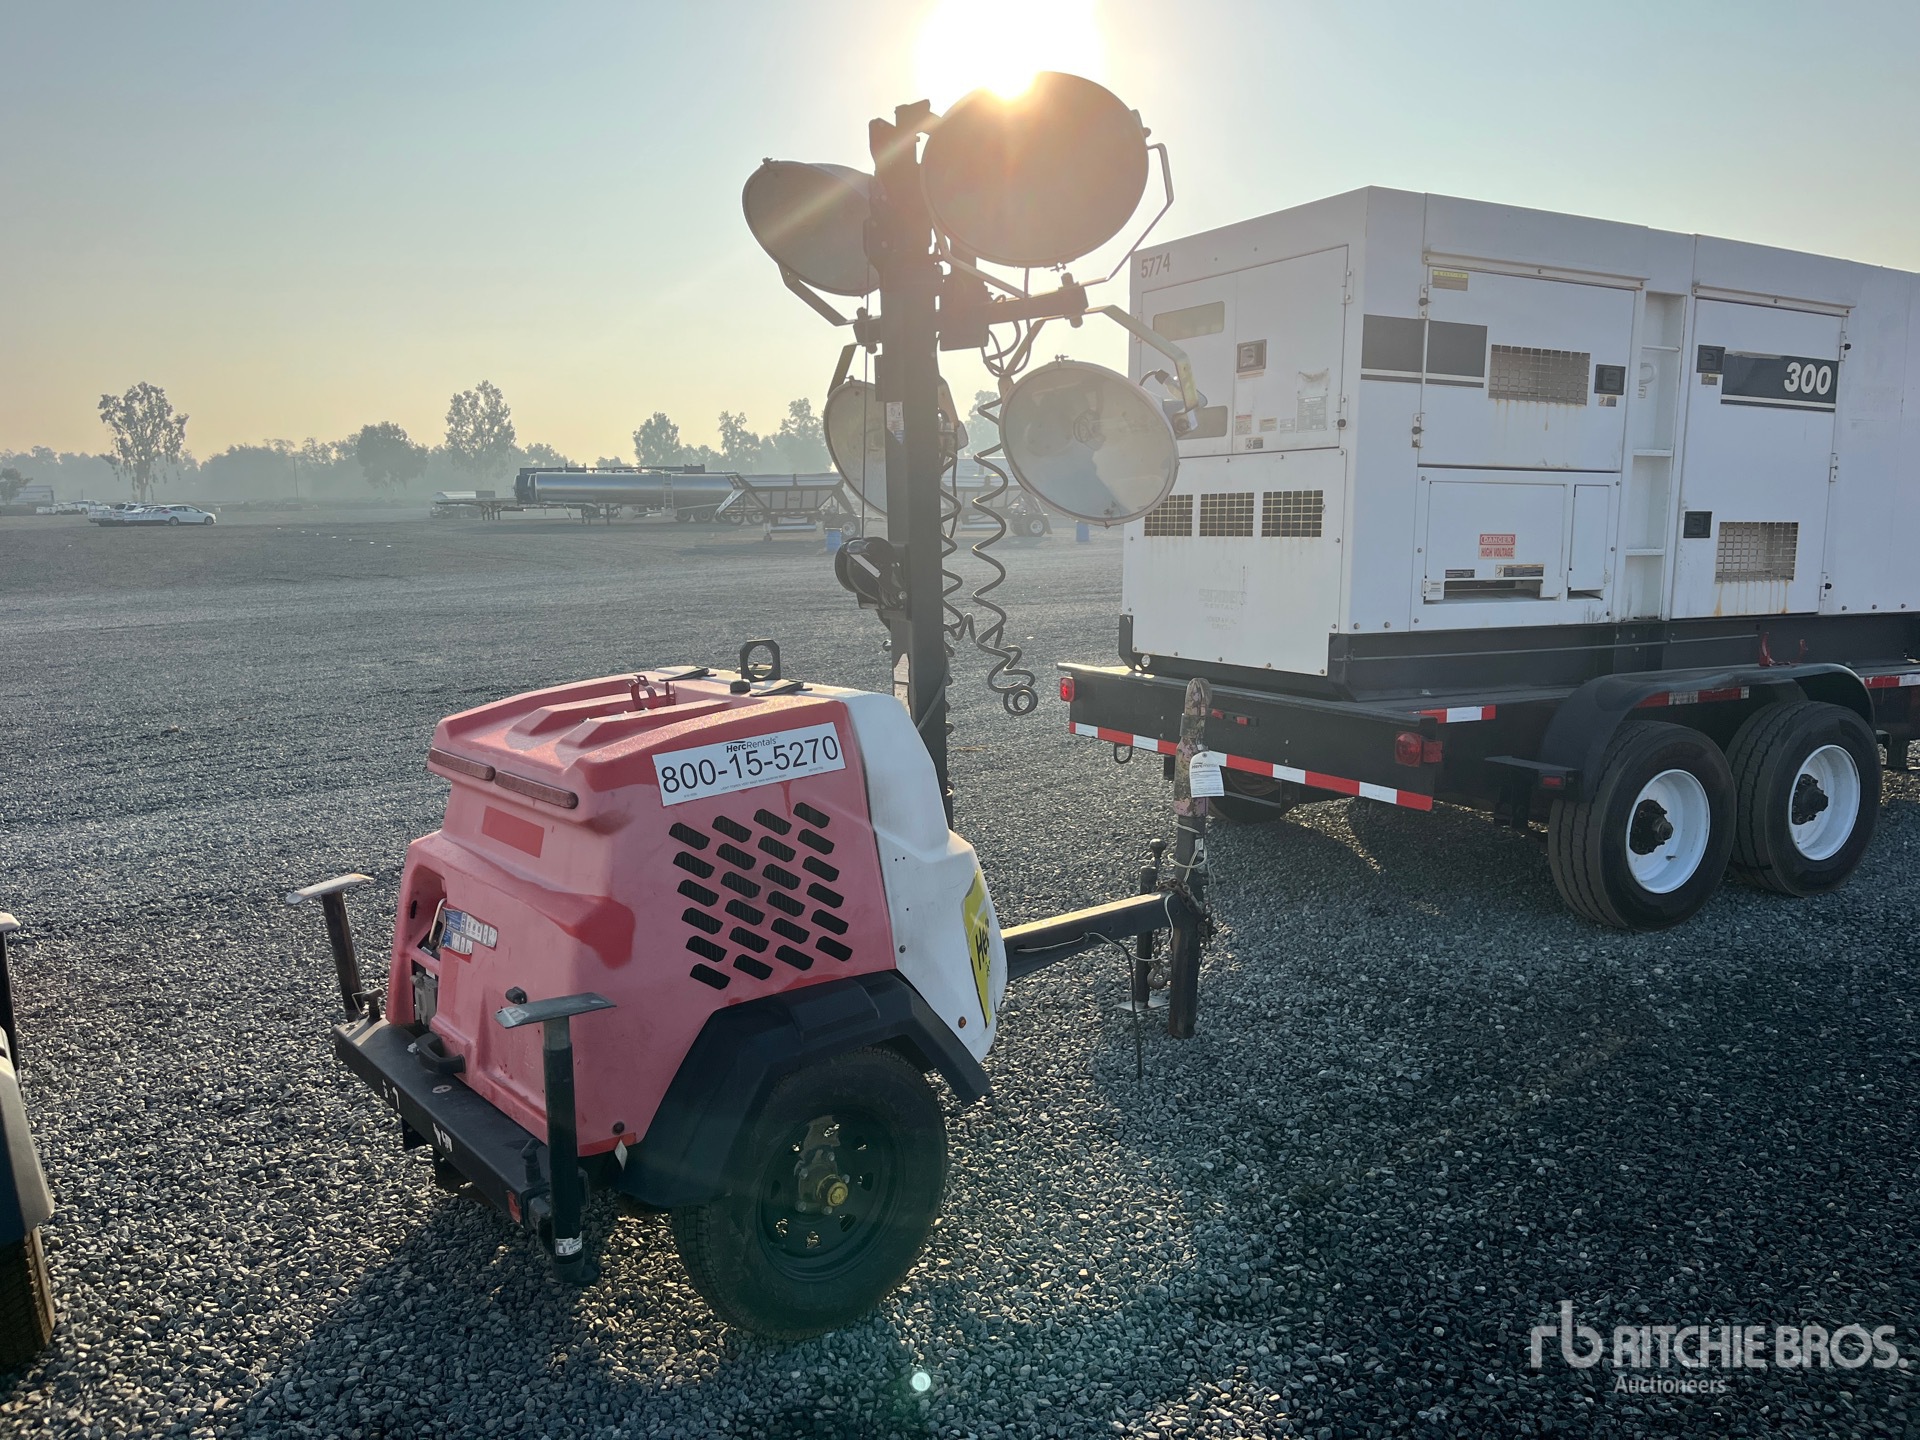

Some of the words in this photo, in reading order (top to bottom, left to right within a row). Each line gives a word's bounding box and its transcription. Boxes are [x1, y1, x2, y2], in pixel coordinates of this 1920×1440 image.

[1141, 252, 1170, 278] 5774
[1784, 361, 1832, 395] 300
[1481, 547, 1493, 557] HIGH
[1494, 547, 1514, 557] VOLTAGE
[1482, 536, 1513, 544] DANGER
[661, 735, 838, 793] 800-15-5270
